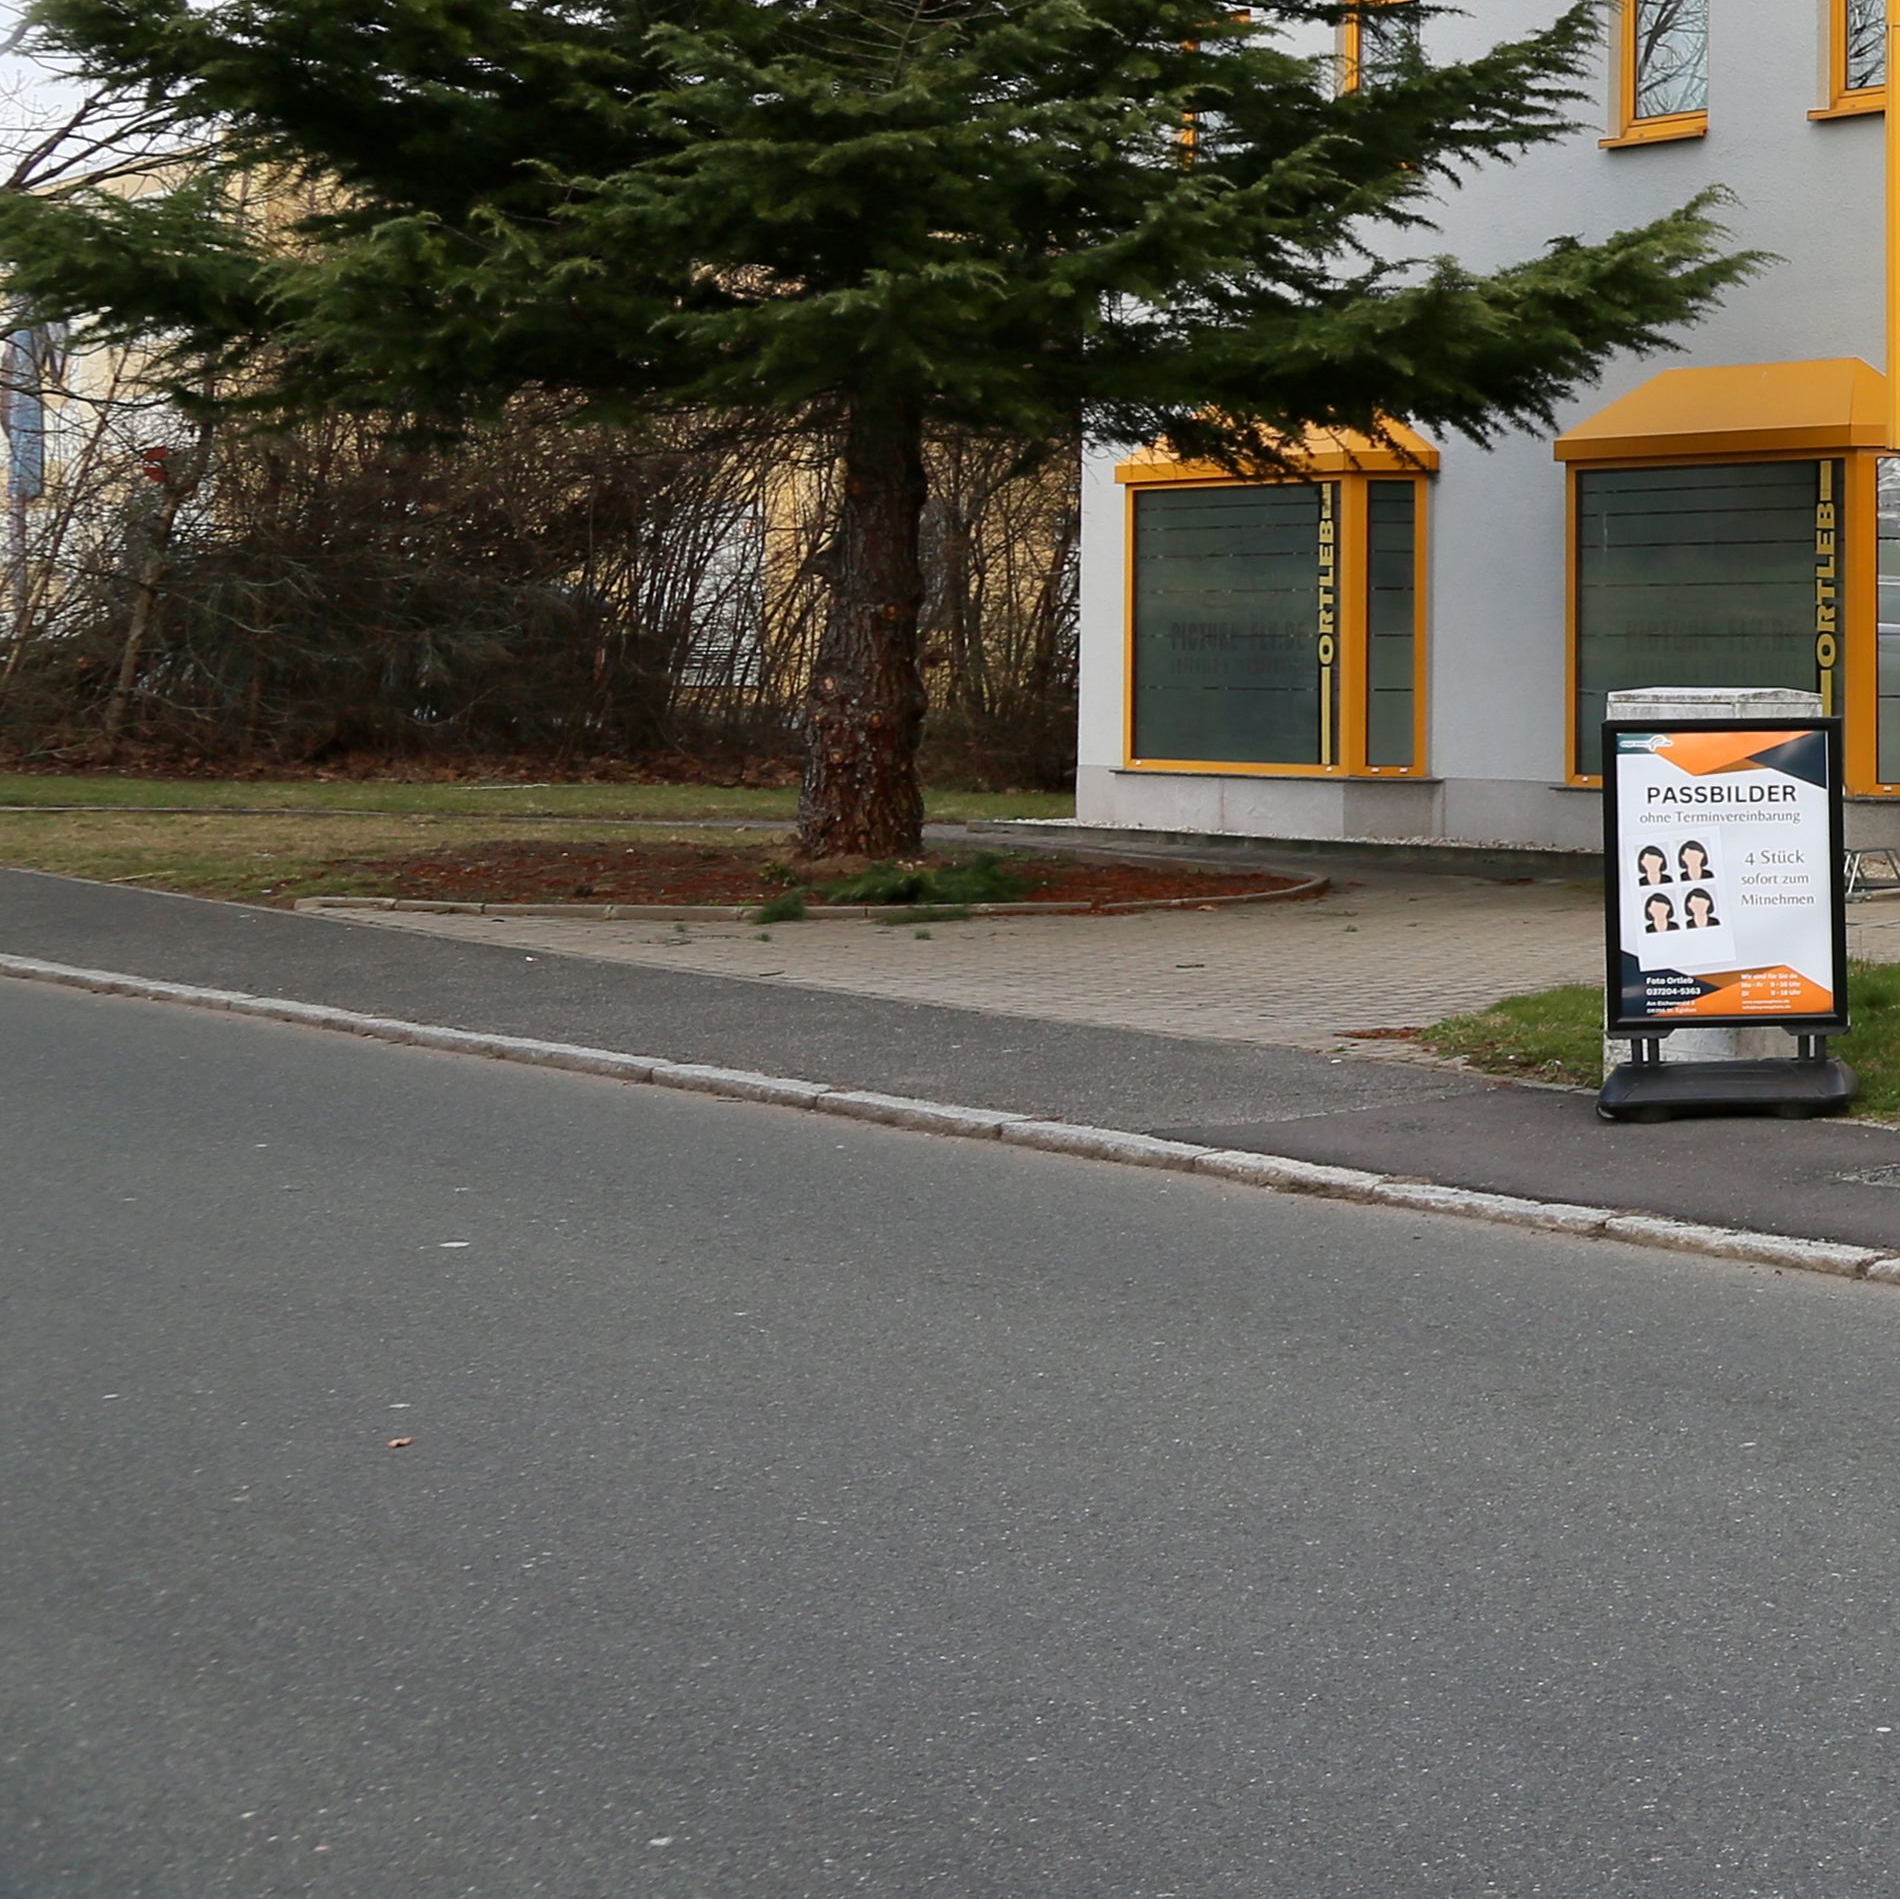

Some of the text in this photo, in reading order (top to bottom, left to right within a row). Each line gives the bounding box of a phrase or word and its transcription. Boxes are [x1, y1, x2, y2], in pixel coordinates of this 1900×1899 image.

[1318, 519, 1335, 666] ORTLEB
[1816, 502, 1837, 668] ORTLEB
[1647, 784, 1797, 804] PASSBILDER
[1639, 809, 1801, 825] ohne Terminvereinbarung
[1744, 849, 1805, 865] 4 Stück
[1741, 872, 1809, 885] sofort zum
[1741, 893, 1815, 905] Mitnehmen
[1646, 977, 1666, 985] Foto
